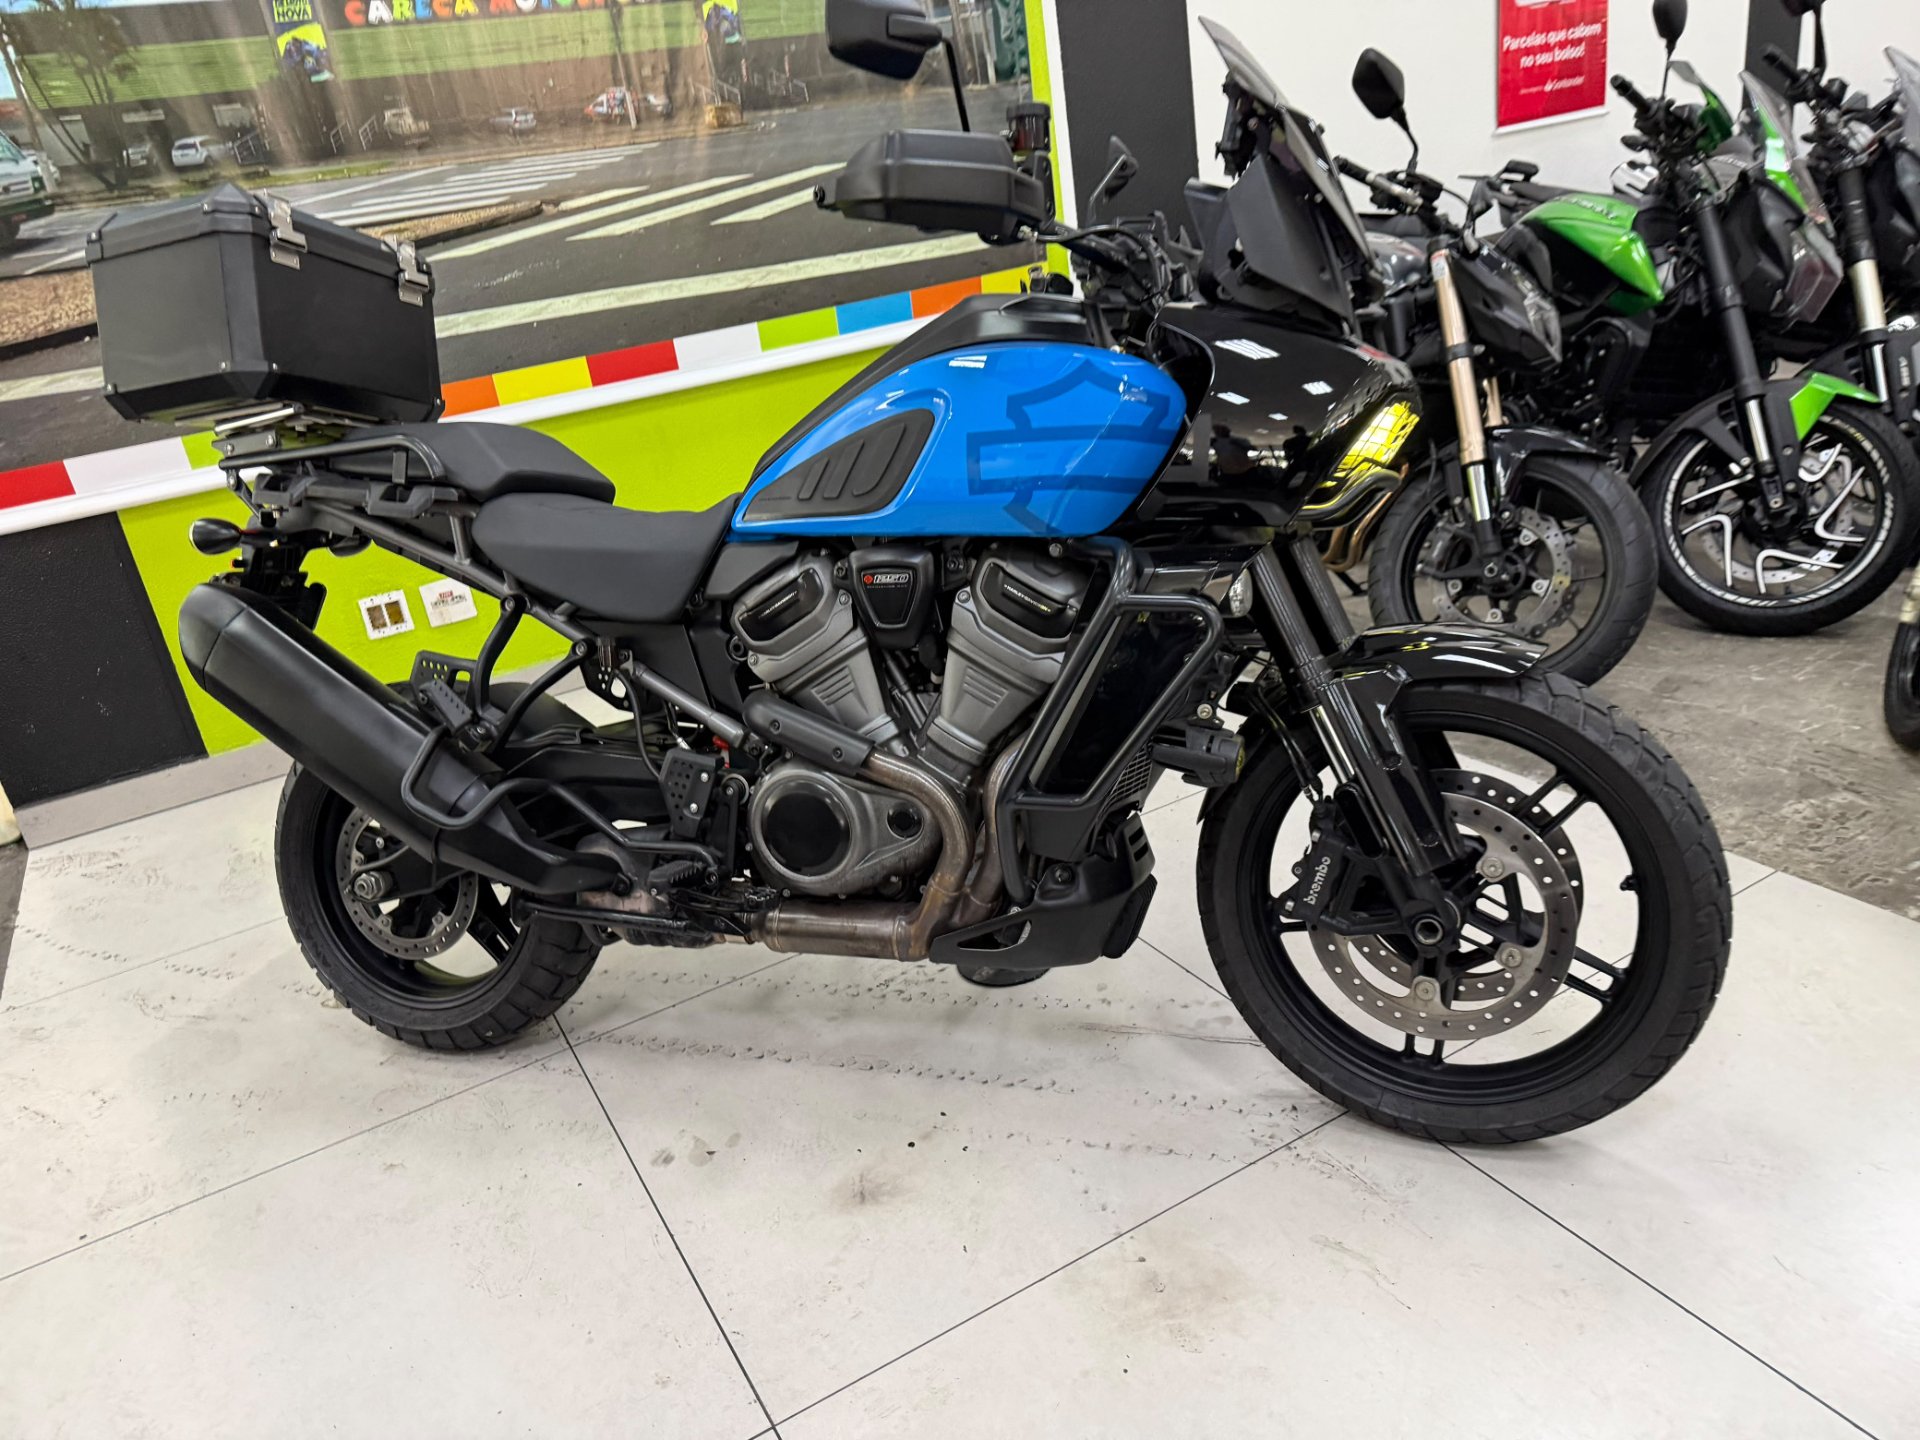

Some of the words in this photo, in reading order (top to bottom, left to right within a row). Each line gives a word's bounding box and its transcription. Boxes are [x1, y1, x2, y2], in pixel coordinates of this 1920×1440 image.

[1502, 32, 1546, 51] Parcelas
[1547, 28, 1567, 47] que
[1567, 22, 1601, 39] cabem
[1520, 54, 1534, 68] no
[1535, 51, 1554, 66] seu
[1303, 856, 1331, 905] brembo
